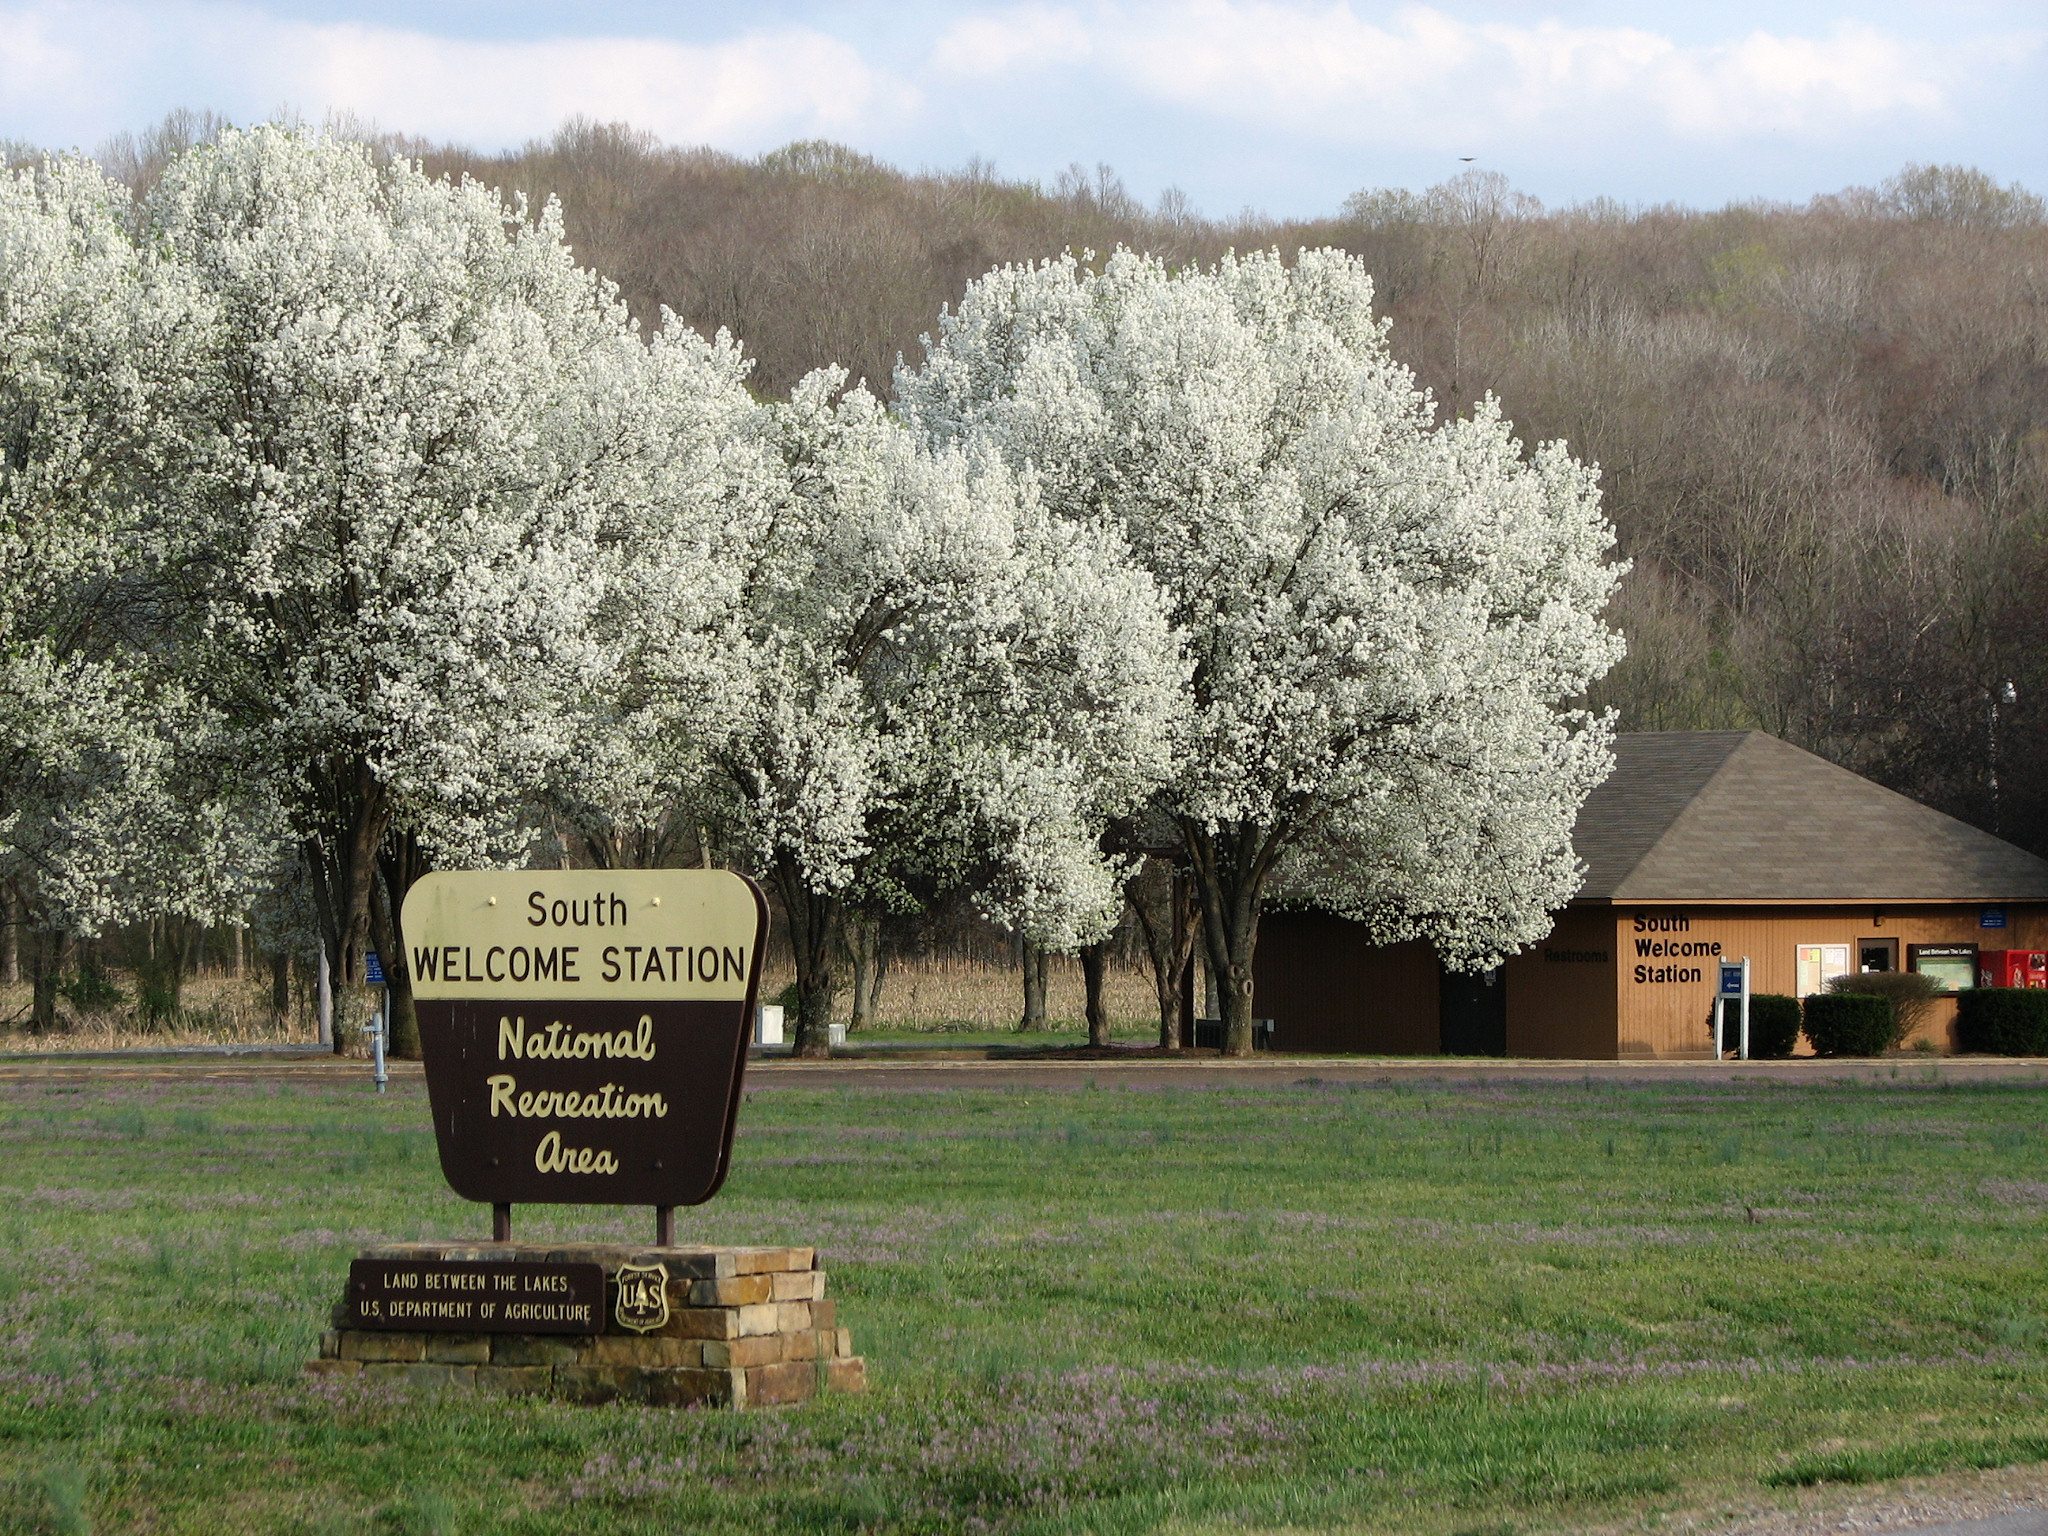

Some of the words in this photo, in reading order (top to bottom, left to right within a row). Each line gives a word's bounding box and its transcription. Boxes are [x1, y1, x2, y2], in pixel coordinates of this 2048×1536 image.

[527, 891, 627, 926] South
[1634, 914, 1689, 932] South
[1544, 948, 1608, 963] Restrooms
[1635, 939, 1721, 957] Welcome
[414, 946, 580, 982] WELCOME
[601, 946, 744, 982] STATION
[1634, 965, 1701, 983] Station
[499, 1014, 656, 1061] National
[486, 1074, 668, 1119] Recreation
[535, 1130, 619, 1175] Area
[384, 1273, 418, 1289] LAND
[425, 1273, 486, 1290] BETWEEN
[493, 1274, 517, 1291] THE
[525, 1276, 568, 1292] LAKES
[360, 1301, 383, 1316] U.S.
[389, 1301, 472, 1318] DEPARTMENT
[480, 1302, 496, 1318] OF
[504, 1304, 591, 1321] AGRICULTURE
